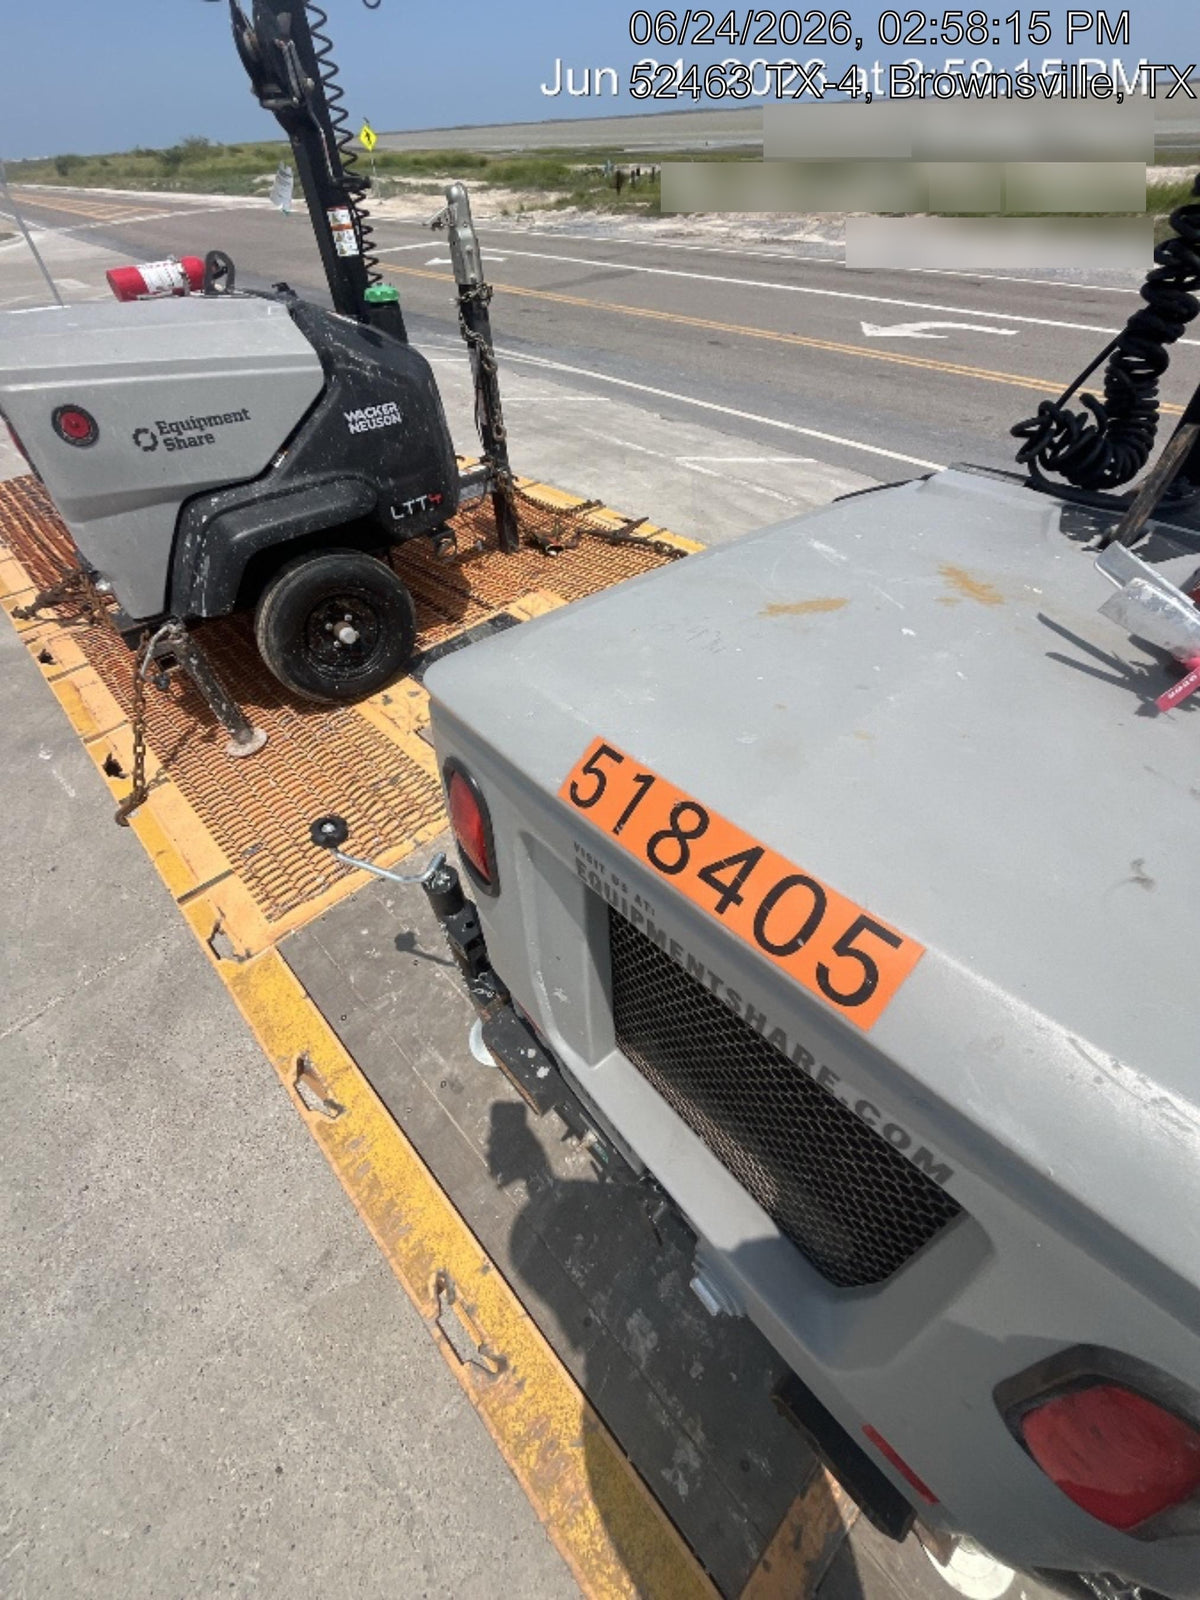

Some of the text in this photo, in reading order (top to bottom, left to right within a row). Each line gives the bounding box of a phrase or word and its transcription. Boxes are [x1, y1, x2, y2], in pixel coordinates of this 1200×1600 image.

[154, 408, 252, 436] Equipment
[343, 402, 399, 422] WACKER
[348, 412, 403, 434] NEUSON
[163, 433, 216, 452] Share
[569, 743, 903, 1007] 518405
[575, 857, 954, 1186] EQUIPMENTSHARE.COM
